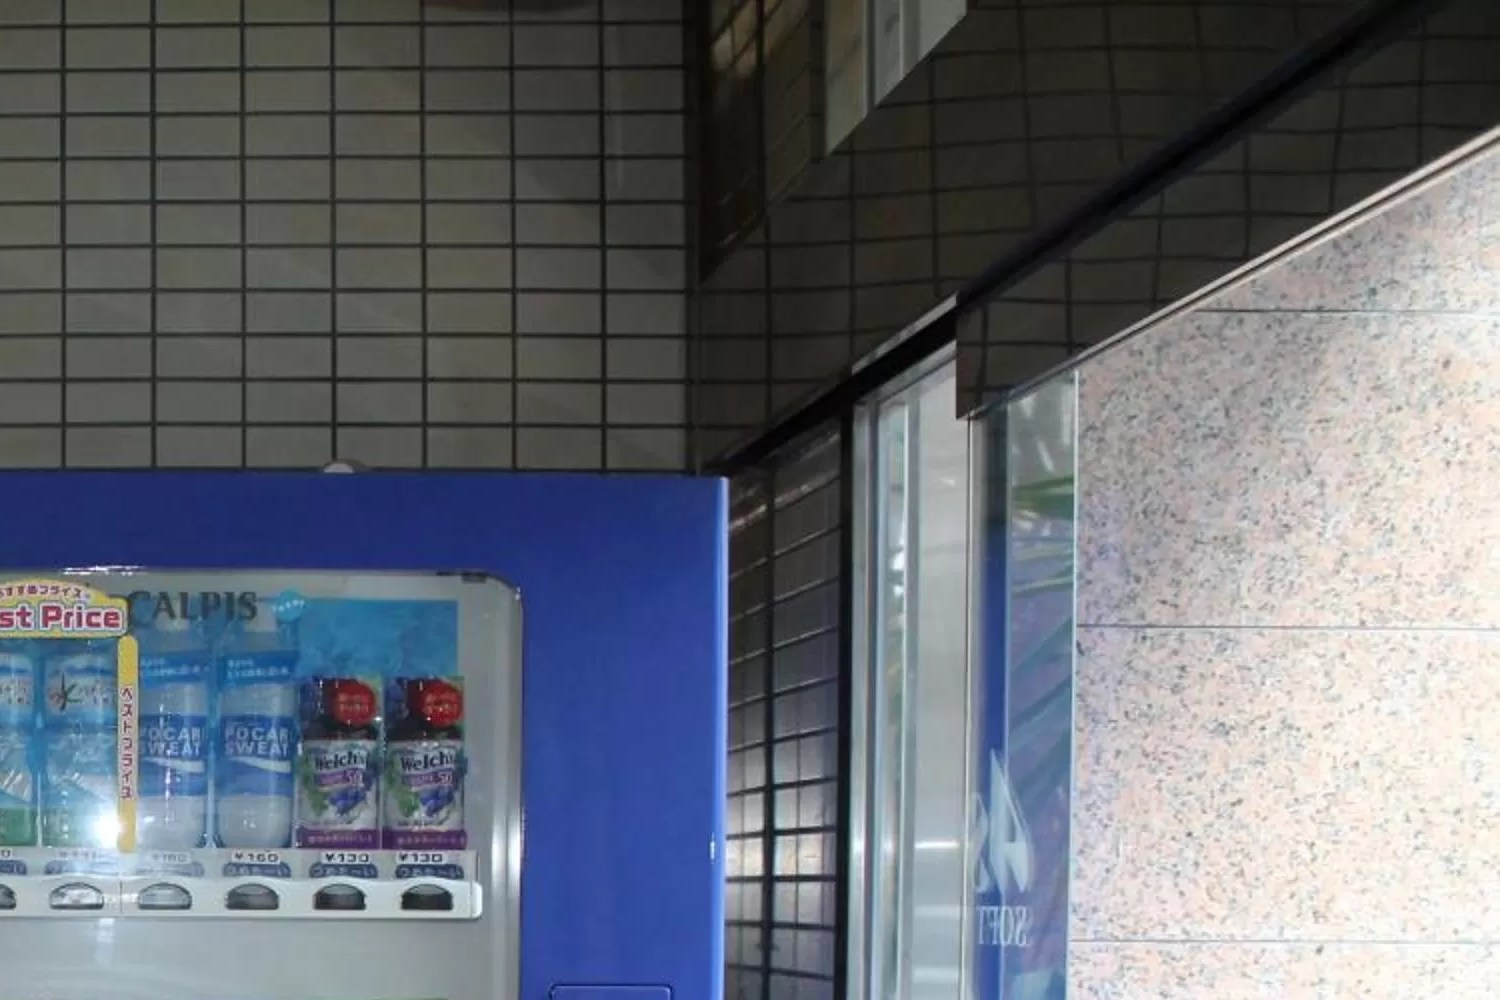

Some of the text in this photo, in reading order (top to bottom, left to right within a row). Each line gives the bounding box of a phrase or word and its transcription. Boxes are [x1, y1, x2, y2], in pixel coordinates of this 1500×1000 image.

[41, 605, 121, 628] Price
[129, 590, 257, 626] CALPIS
[399, 852, 443, 863] ¥130
